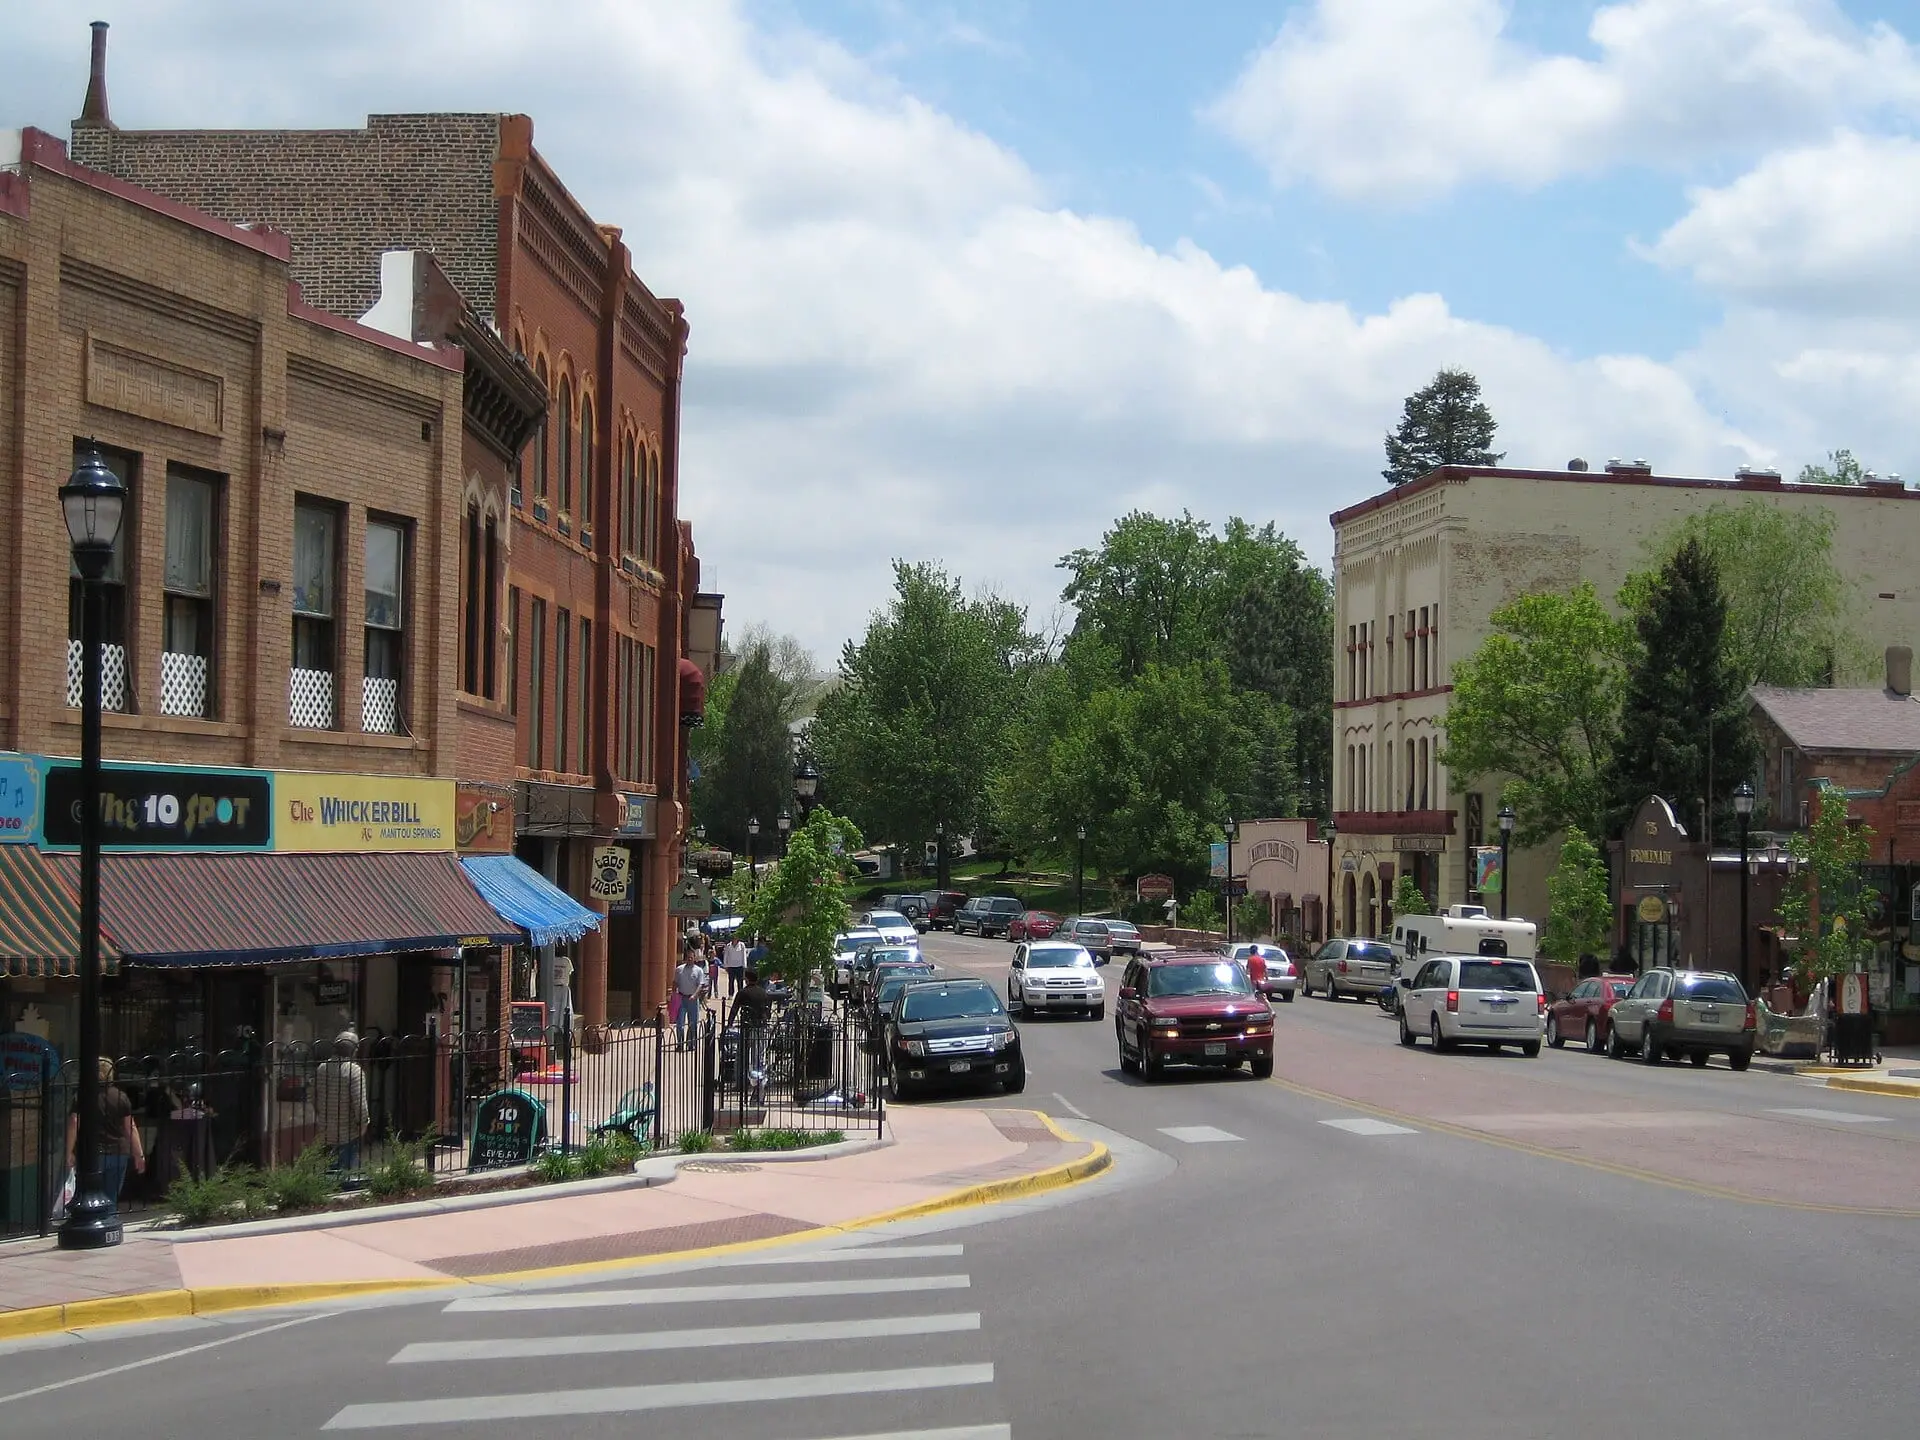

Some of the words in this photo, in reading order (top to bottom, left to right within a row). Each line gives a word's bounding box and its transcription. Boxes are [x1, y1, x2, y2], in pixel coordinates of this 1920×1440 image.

[144, 794, 180, 824] 10
[290, 800, 314, 822] The
[319, 797, 421, 825] WHICKERBILL
[380, 828, 411, 839] MANITOU
[412, 828, 441, 839] SPRINGS
[1630, 849, 1673, 865] PROMENADE
[498, 1108, 518, 1121] 10
